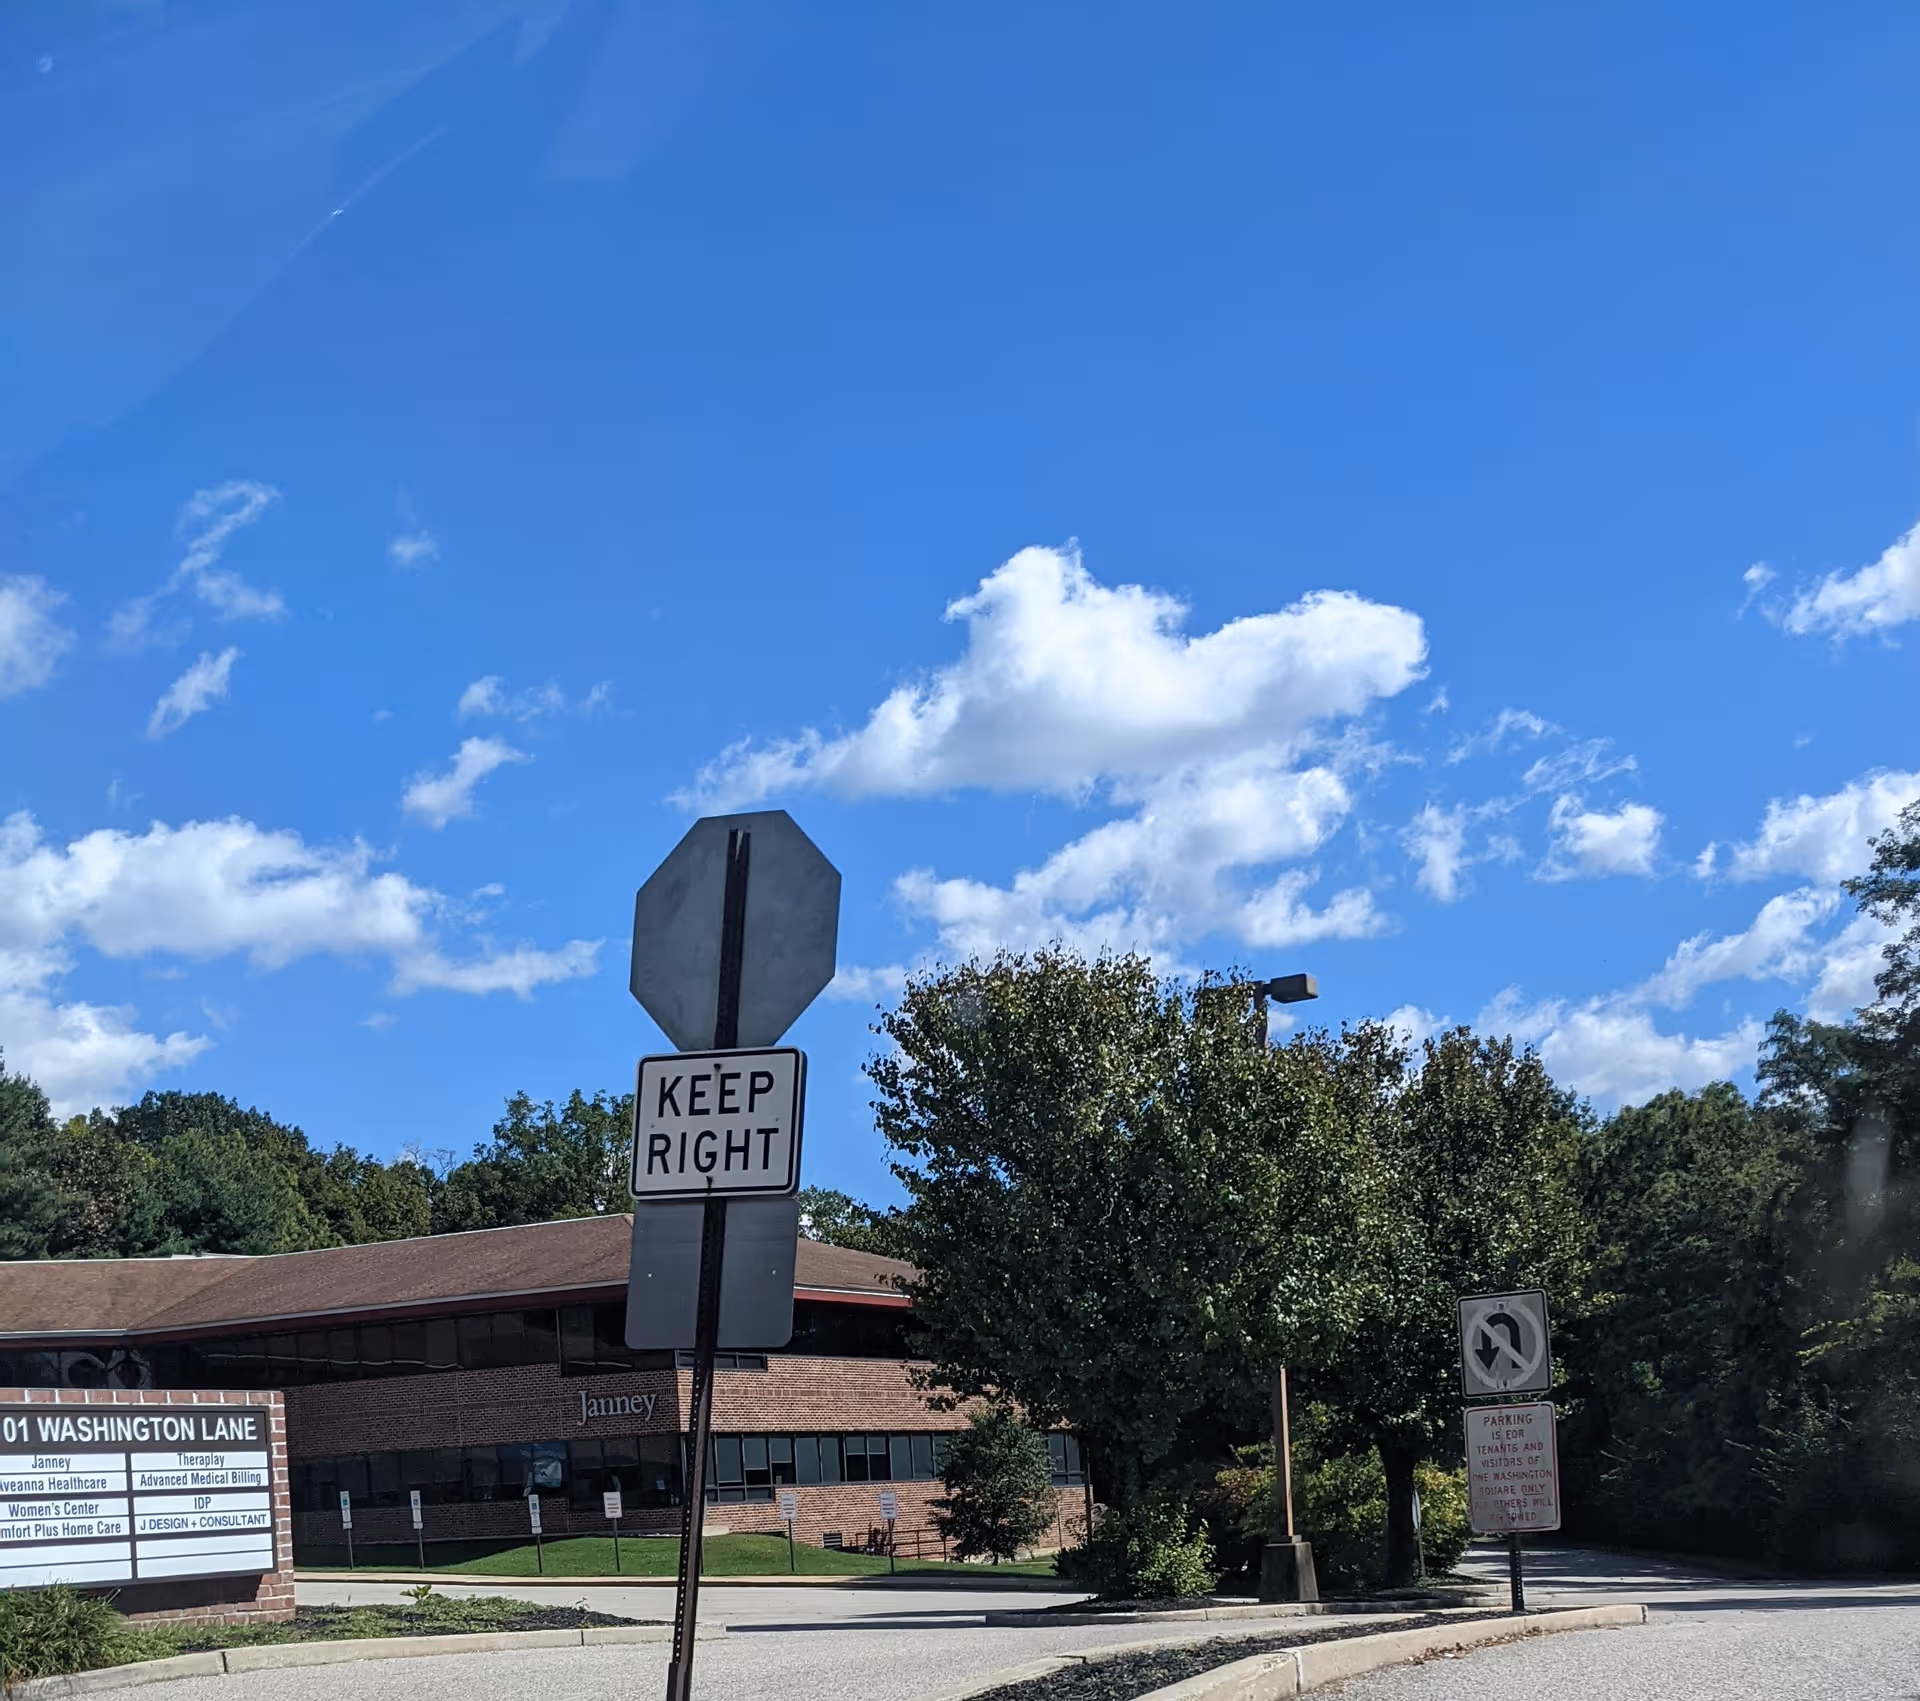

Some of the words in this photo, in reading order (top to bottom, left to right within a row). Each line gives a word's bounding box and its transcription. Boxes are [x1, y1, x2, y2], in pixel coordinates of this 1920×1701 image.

[658, 1070, 775, 1118] KEEP
[647, 1127, 779, 1175] RIGHT
[577, 1391, 657, 1427] Janney
[1483, 1413, 1533, 1427] PARKING
[2, 1416, 29, 1443] 01
[37, 1415, 195, 1443] WASHINGTON
[201, 1416, 258, 1441] LANE
[1491, 1430, 1501, 1440] IS
[1476, 1443, 1518, 1455] TENANTS
[1523, 1441, 1544, 1452] AND
[31, 1455, 71, 1472] Janney
[177, 1452, 225, 1468] Theraplay
[1481, 1457, 1523, 1468] VISITORS
[1527, 1455, 1541, 1465] OF
[48, 1476, 107, 1491] Healthcare
[140, 1473, 188, 1487] Advanced
[191, 1472, 228, 1485] Medical
[232, 1470, 262, 1486] Billing
[1472, 1472, 1489, 1482] ONE
[1493, 1469, 1553, 1481] WASHINGTON
[1479, 1485, 1516, 1496] SQUARE
[1520, 1483, 1546, 1495] ONLY
[8, 1502, 61, 1517] Women's
[64, 1500, 100, 1515] Center
[194, 1496, 212, 1509] IDP
[1493, 1498, 1528, 1509] OTHERS
[1532, 1497, 1554, 1507] WILL
[0, 1524, 31, 1539] mfort
[35, 1523, 59, 1538] Plus
[62, 1521, 94, 1536] Home
[97, 1520, 121, 1534] Care
[140, 1519, 146, 1531] J
[149, 1517, 189, 1530] DESIGN
[199, 1514, 267, 1528] CONSULTANT
